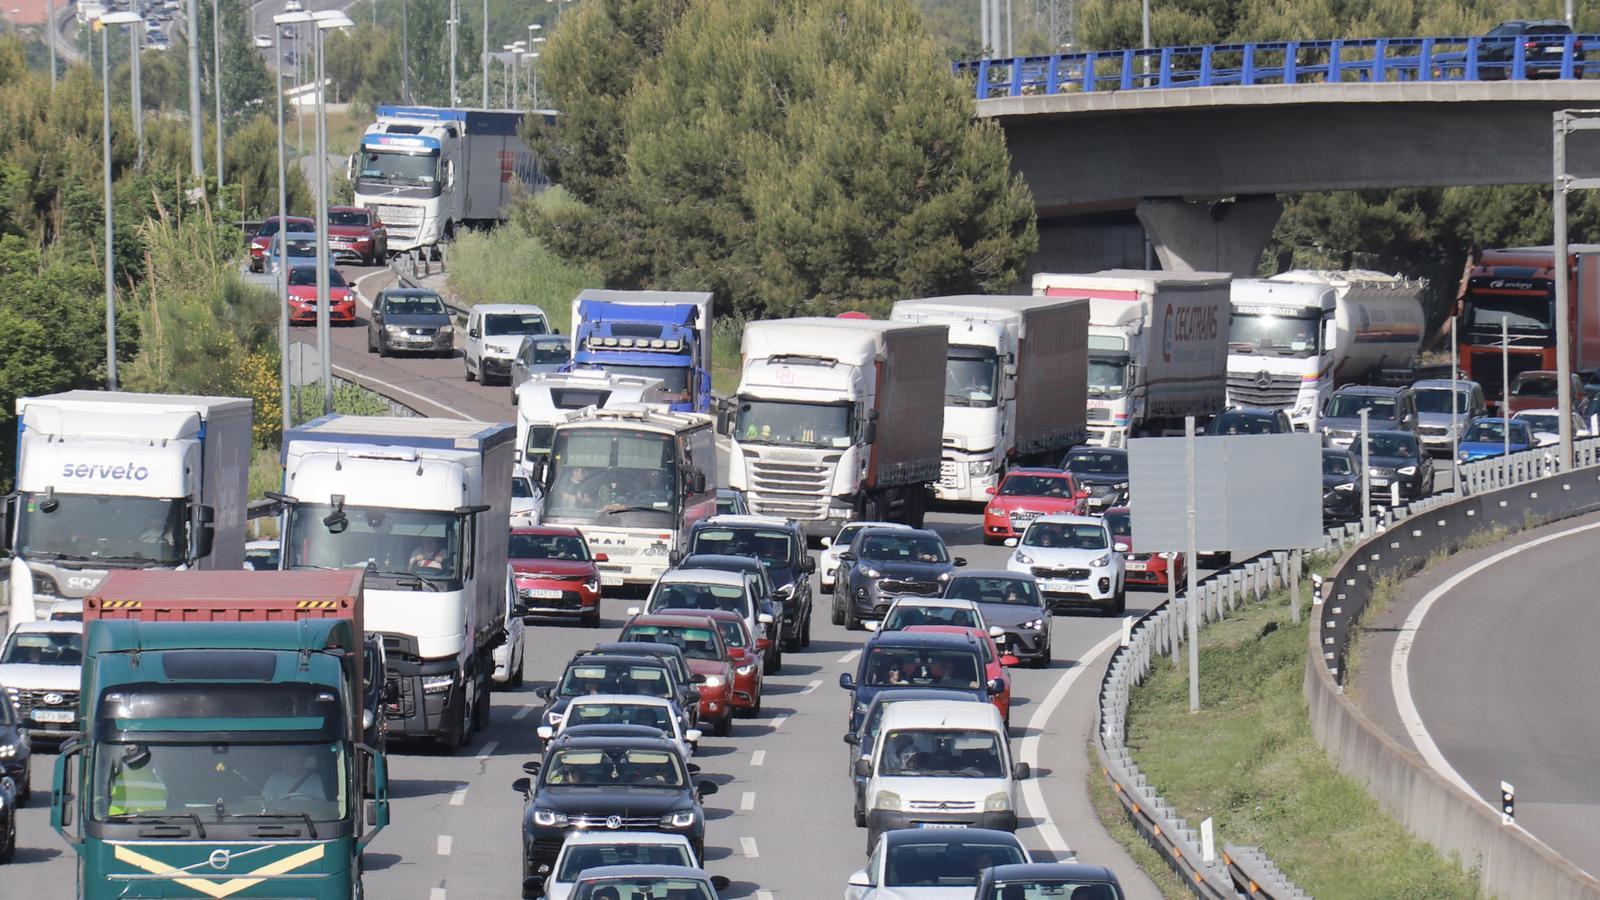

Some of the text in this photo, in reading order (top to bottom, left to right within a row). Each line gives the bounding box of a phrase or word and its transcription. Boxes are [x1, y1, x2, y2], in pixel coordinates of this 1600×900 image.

[1174, 304, 1218, 342] CECATRANS
[62, 461, 150, 482] serveto
[588, 537, 626, 545] MAN
